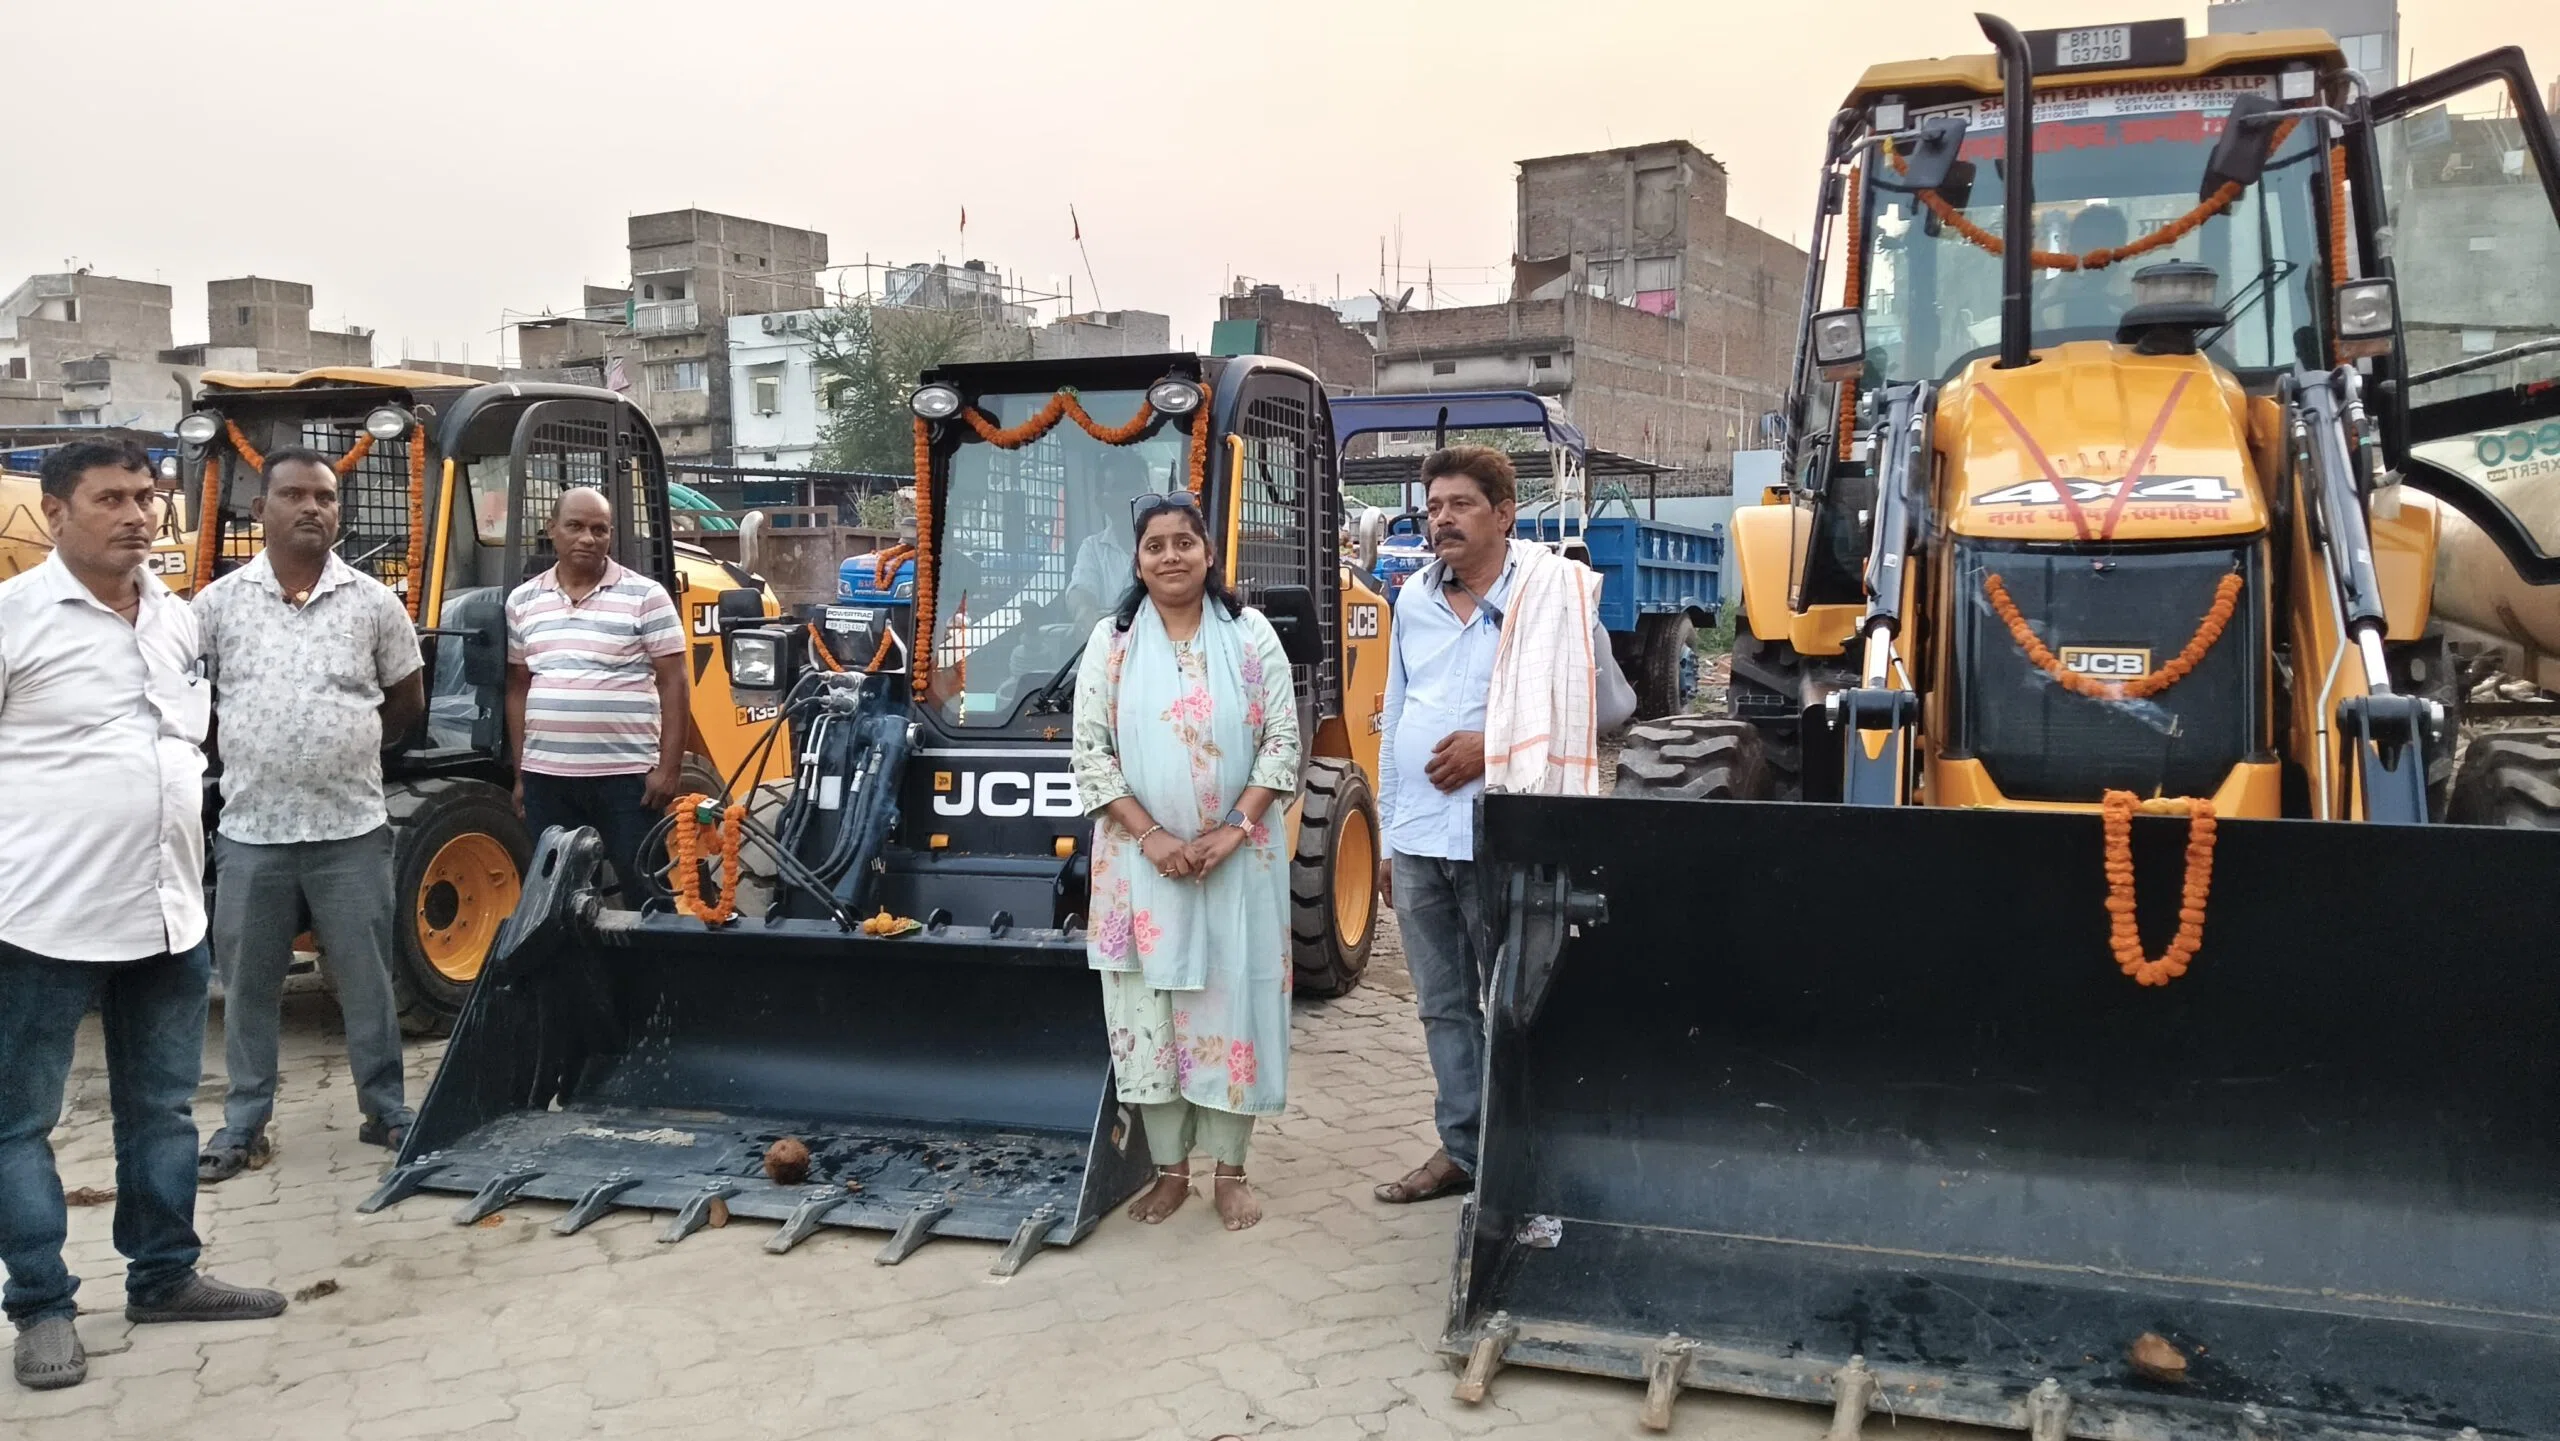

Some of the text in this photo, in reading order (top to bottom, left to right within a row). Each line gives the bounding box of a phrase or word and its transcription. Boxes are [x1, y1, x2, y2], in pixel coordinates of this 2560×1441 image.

[2063, 77, 2224, 104] EARTHMOVERS
[2231, 77, 2267, 90] LLP
[1347, 606, 1377, 636] JCB
[2067, 653, 2143, 674] JCB
[933, 771, 1085, 818] JCB
